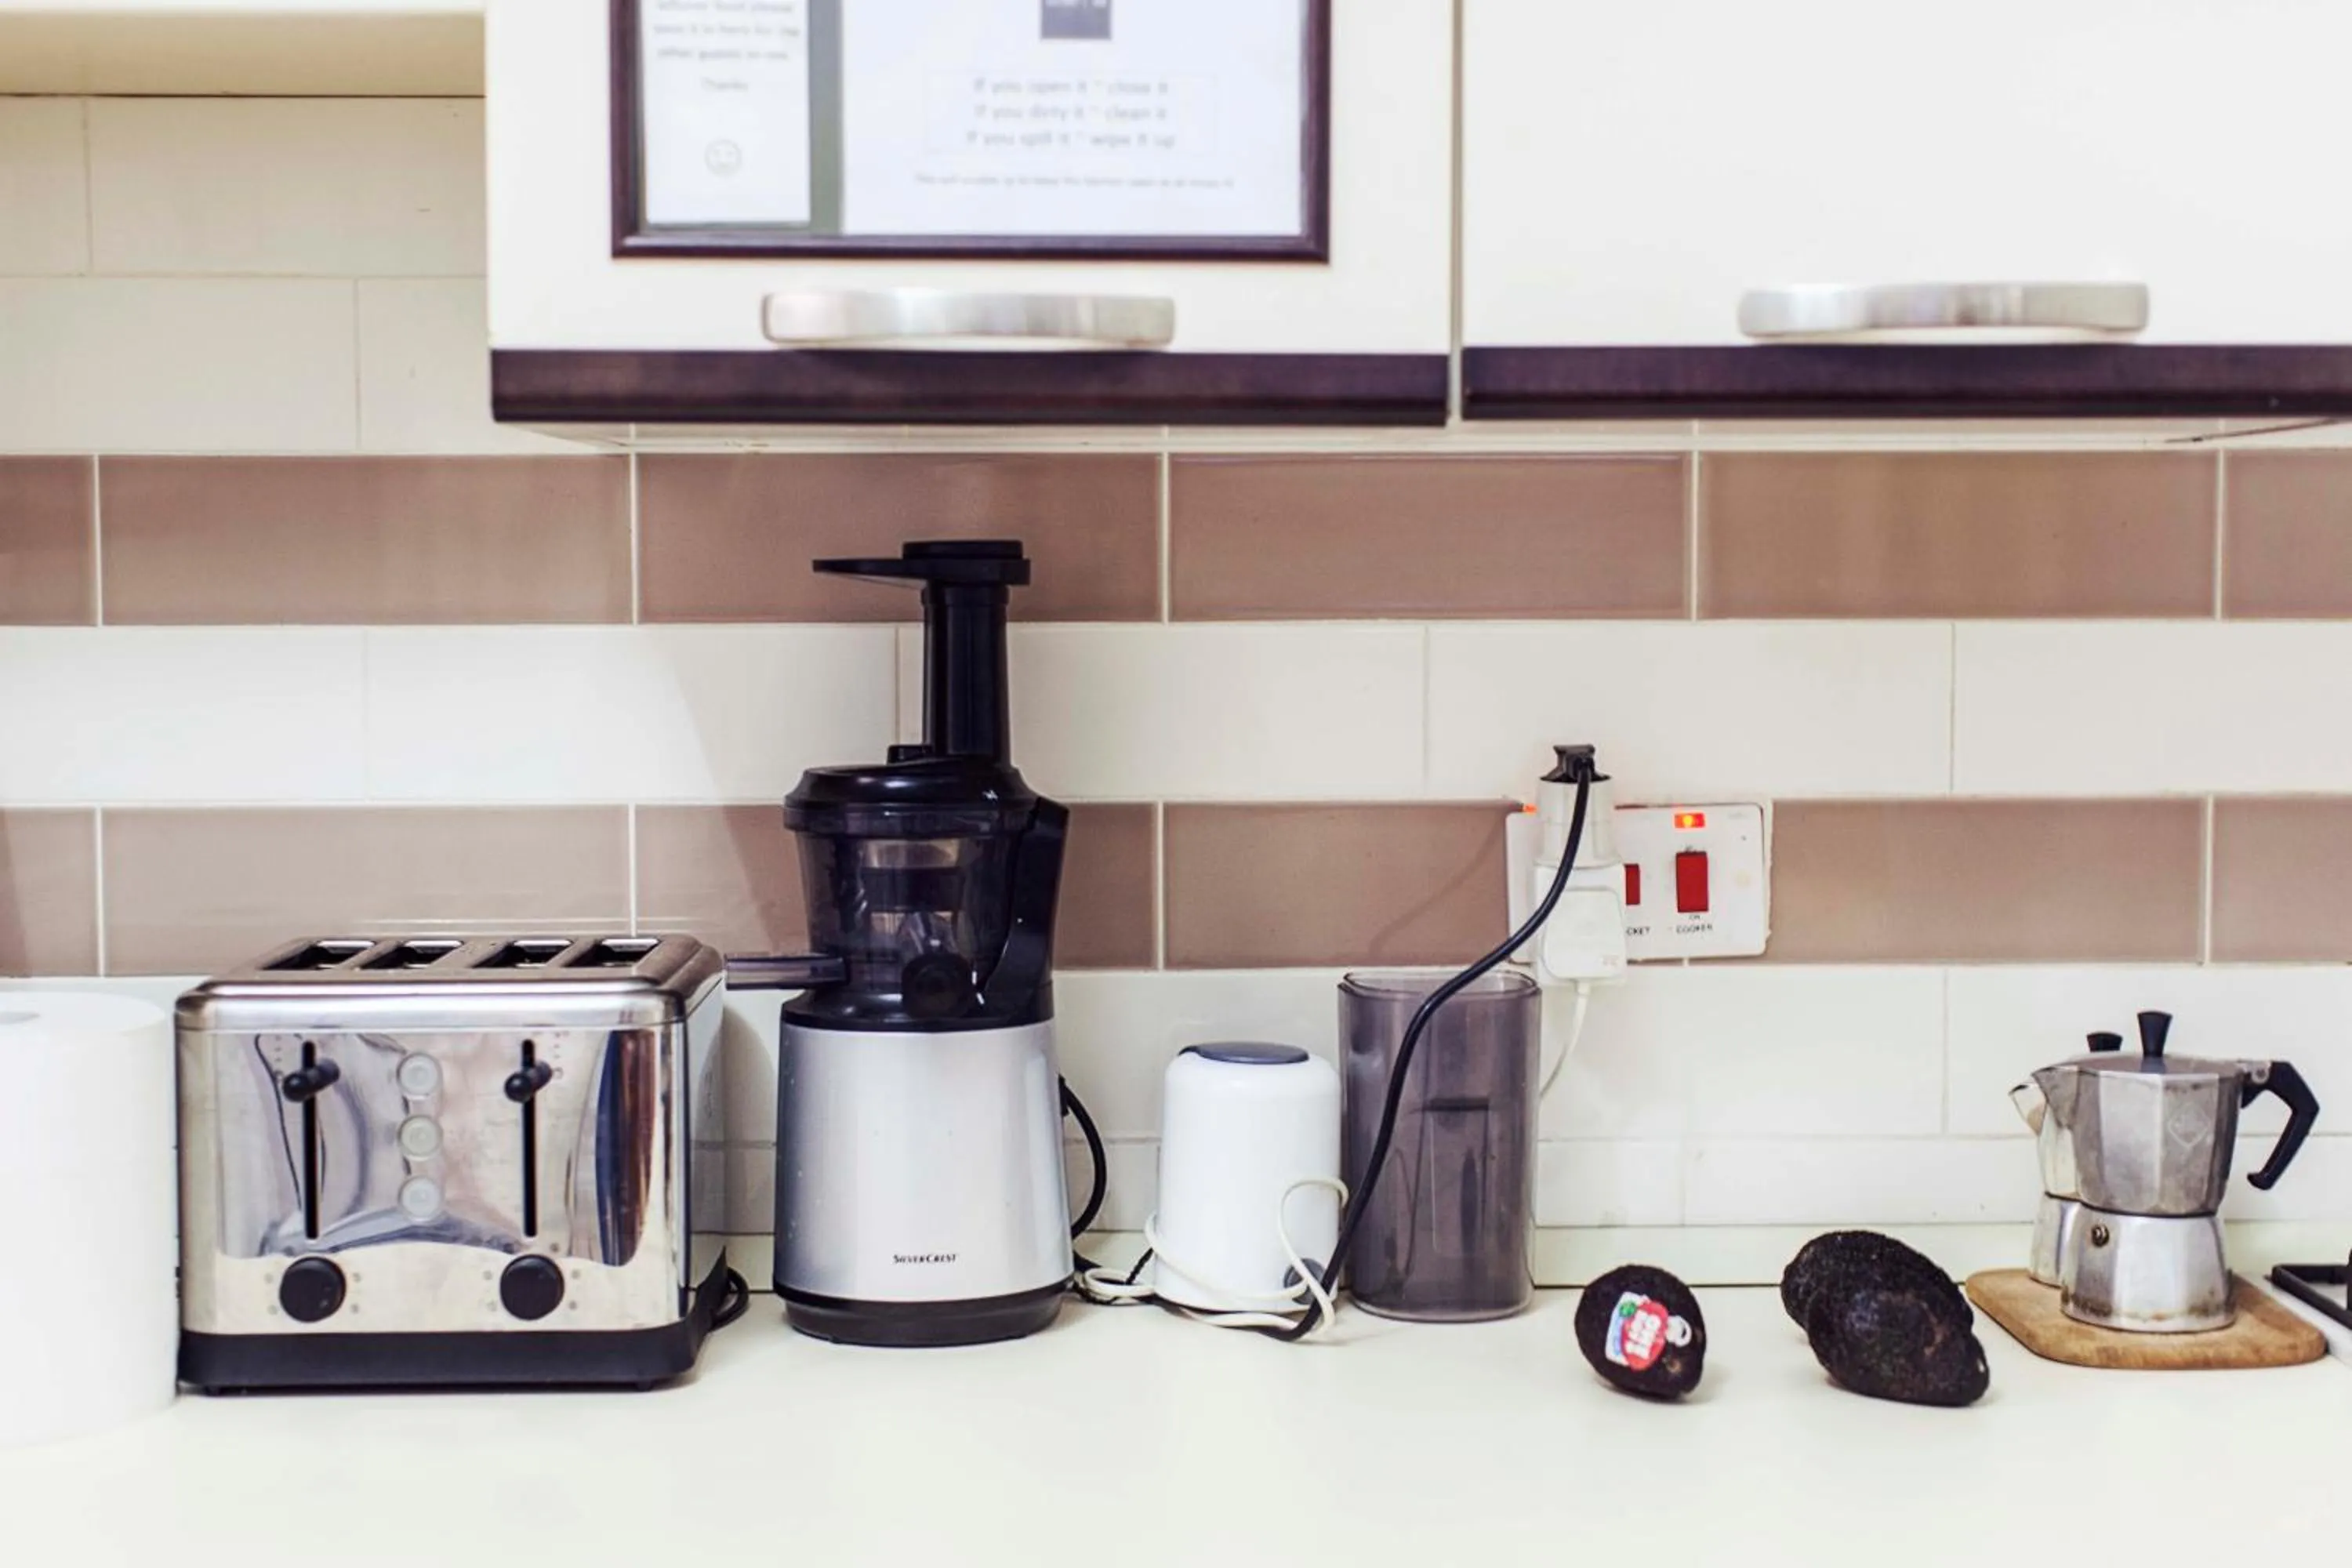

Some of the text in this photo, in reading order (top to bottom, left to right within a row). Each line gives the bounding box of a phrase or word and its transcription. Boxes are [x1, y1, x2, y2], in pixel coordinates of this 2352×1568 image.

[992, 81, 1022, 95] you
[993, 106, 1022, 121] you
[984, 132, 1014, 147] you
[1626, 926, 1650, 936] CKET
